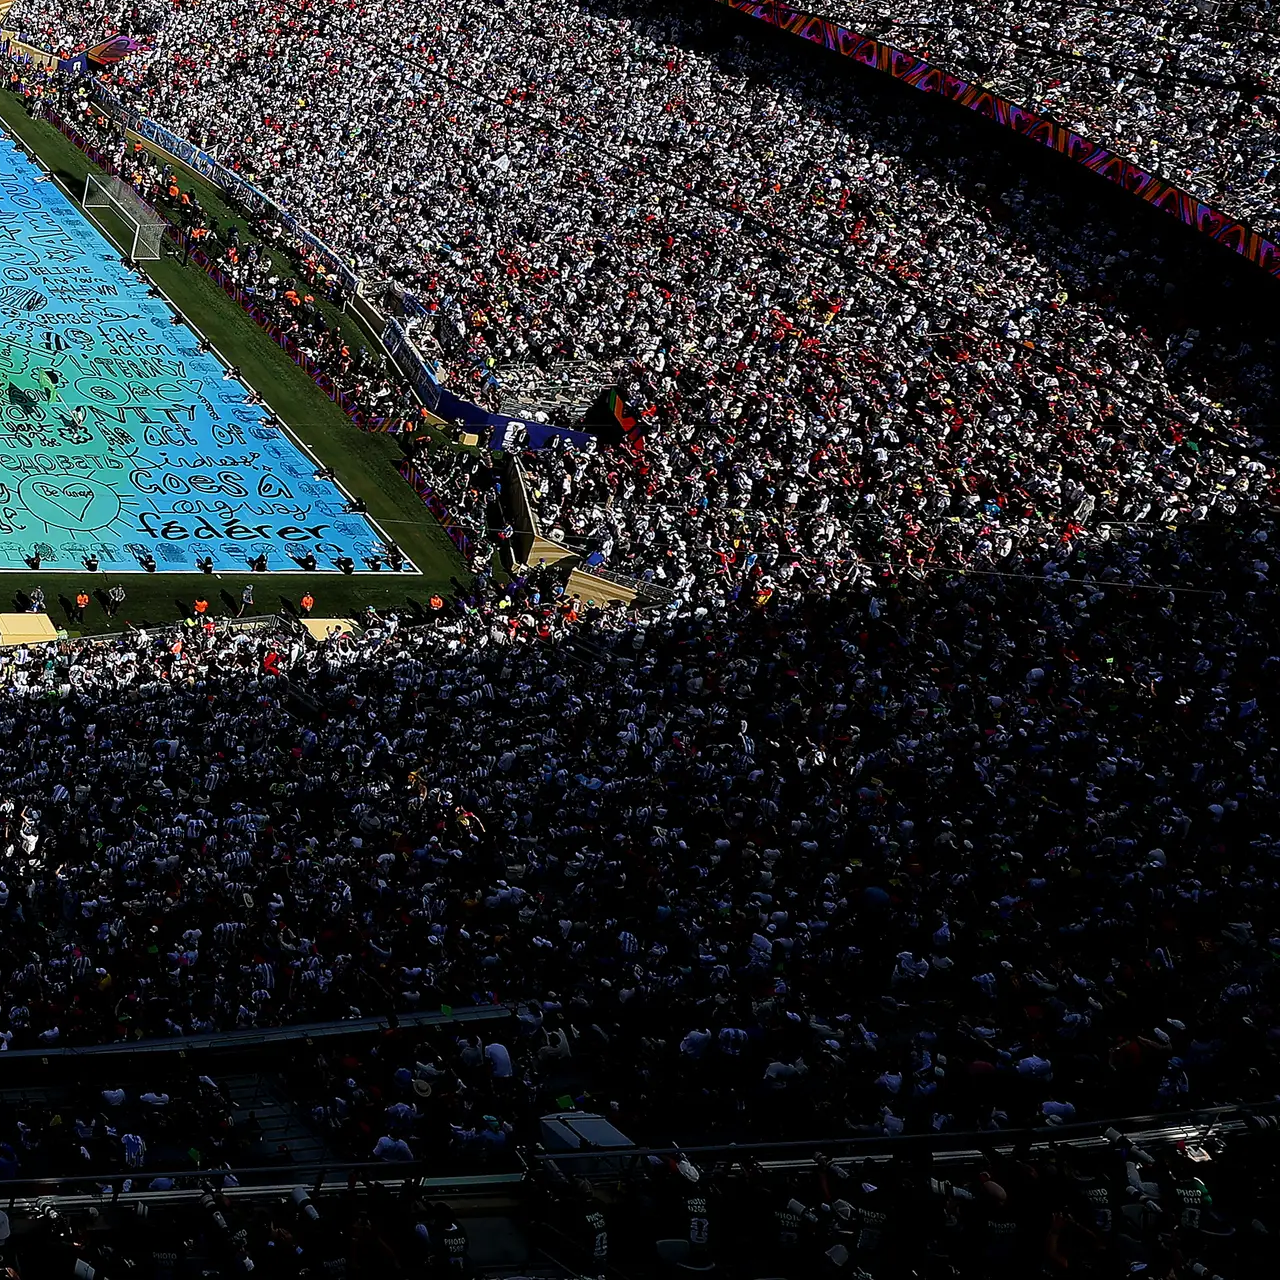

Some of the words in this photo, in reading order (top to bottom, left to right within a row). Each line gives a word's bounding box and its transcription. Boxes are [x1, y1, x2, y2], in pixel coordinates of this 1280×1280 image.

[29, 266, 94, 276] BELIEVE
[97, 325, 155, 343] take
[108, 342, 177, 358] action
[136, 511, 332, 542] fédérer
